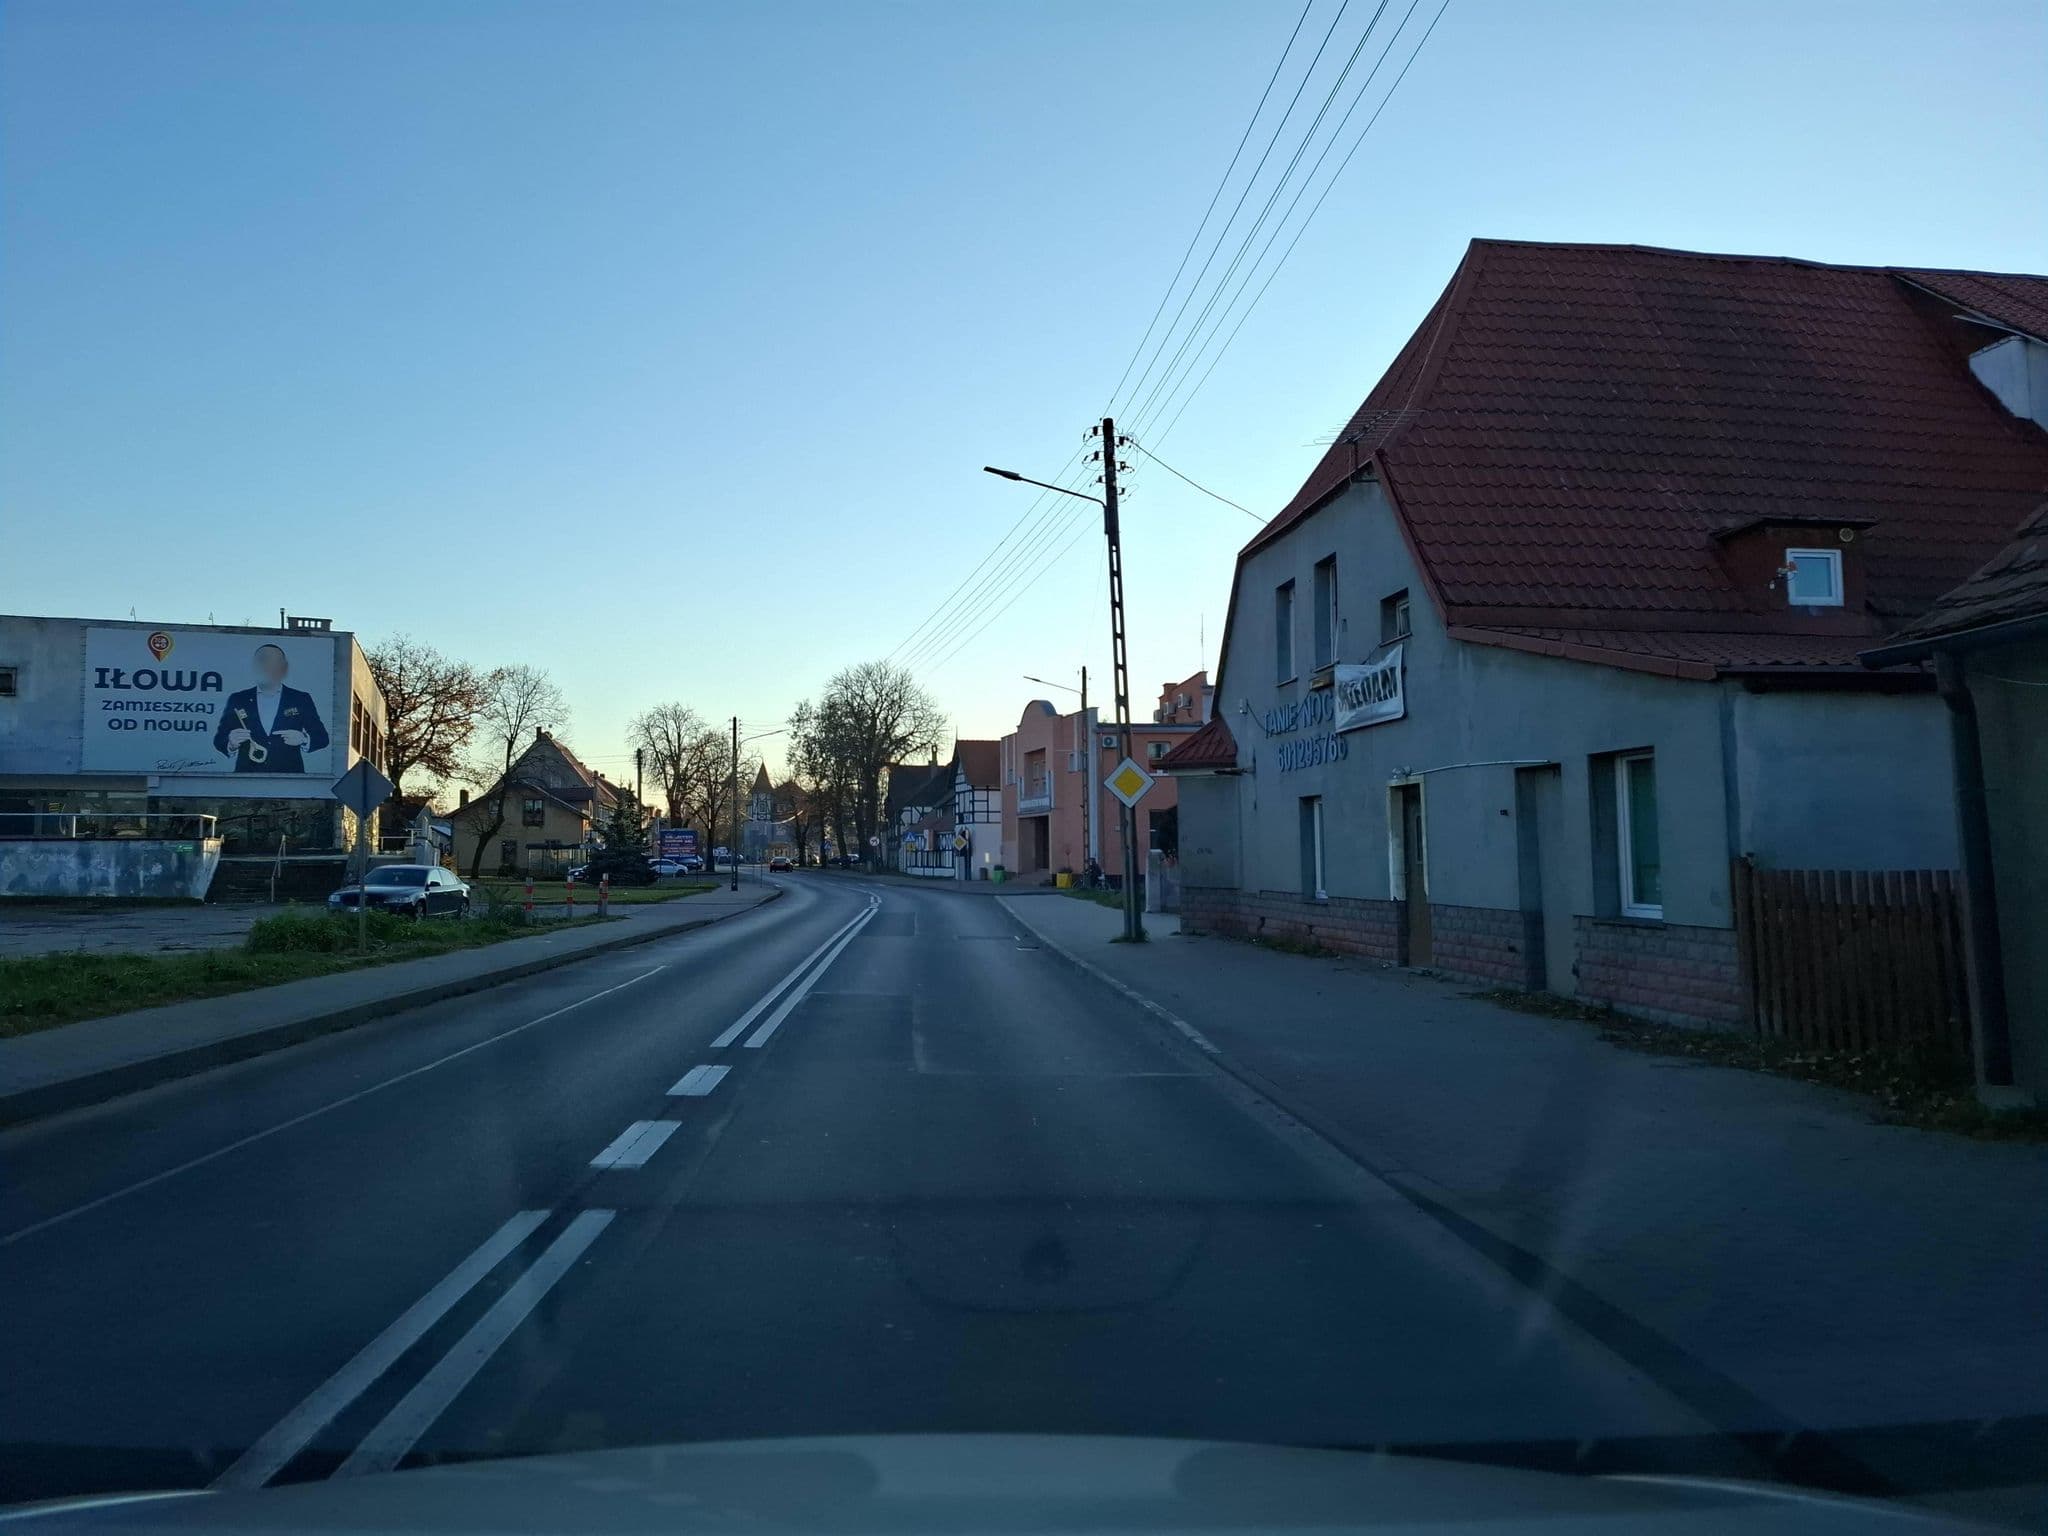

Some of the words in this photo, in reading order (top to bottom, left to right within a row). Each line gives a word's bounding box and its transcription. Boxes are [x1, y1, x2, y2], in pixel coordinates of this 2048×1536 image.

[94, 668, 223, 692] IŁOWA
[102, 700, 215, 714] ZAMIESZKAJ
[1299, 694, 1335, 728] NOC
[108, 718, 137, 731] OD
[144, 719, 207, 732] NOWA
